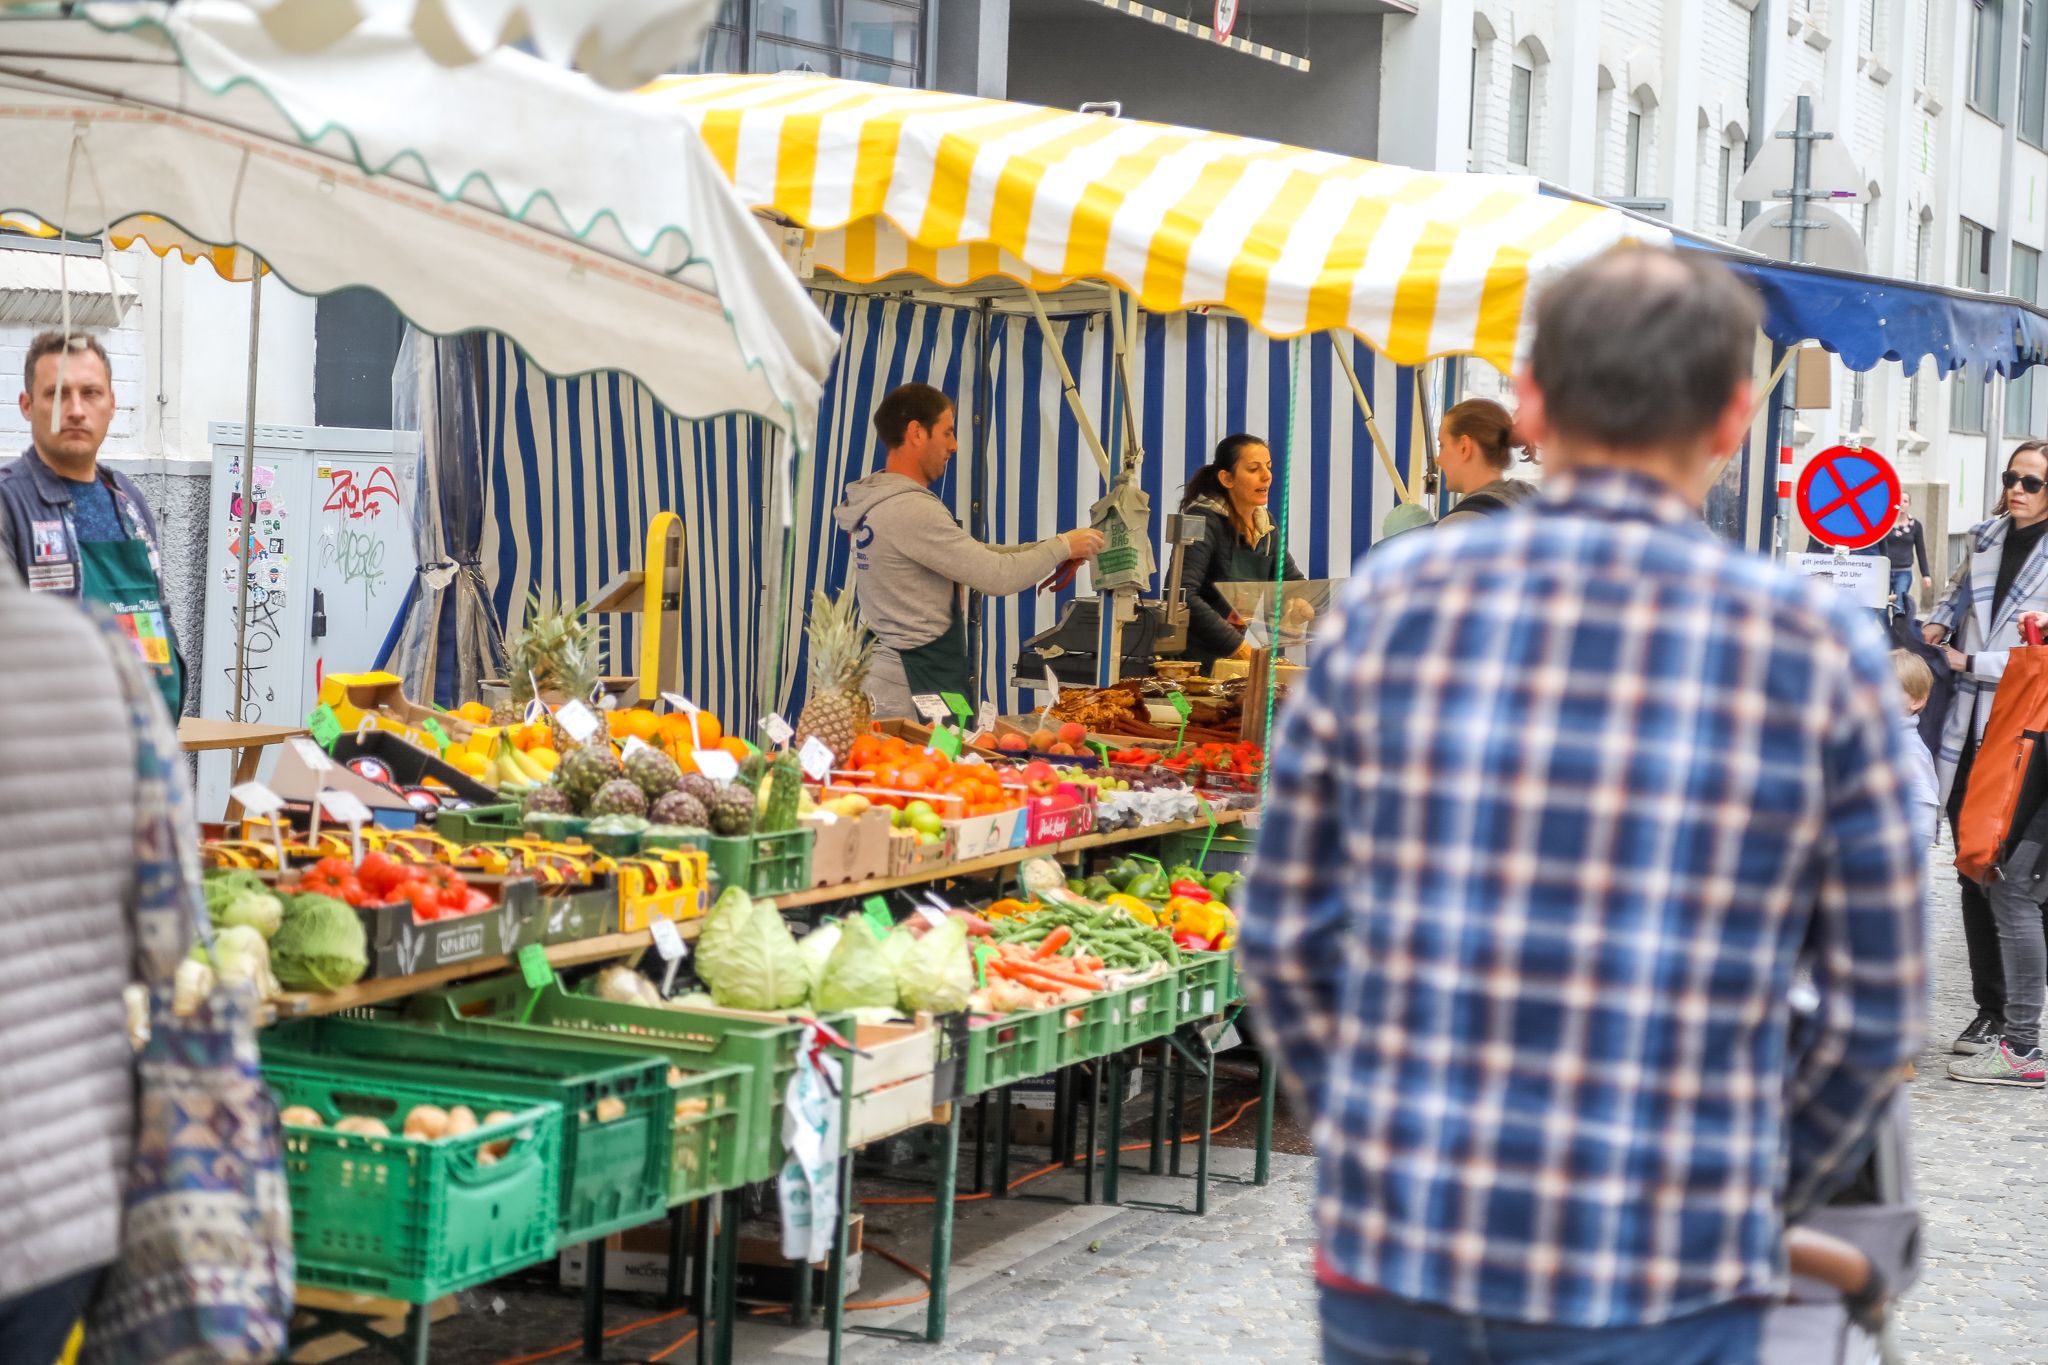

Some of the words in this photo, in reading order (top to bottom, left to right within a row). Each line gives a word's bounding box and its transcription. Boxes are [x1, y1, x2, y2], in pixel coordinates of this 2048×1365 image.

[1111, 533, 1129, 547] BAG
[1833, 559, 1872, 568] Donnerstag
[625, 1264, 668, 1278] NICOFR
